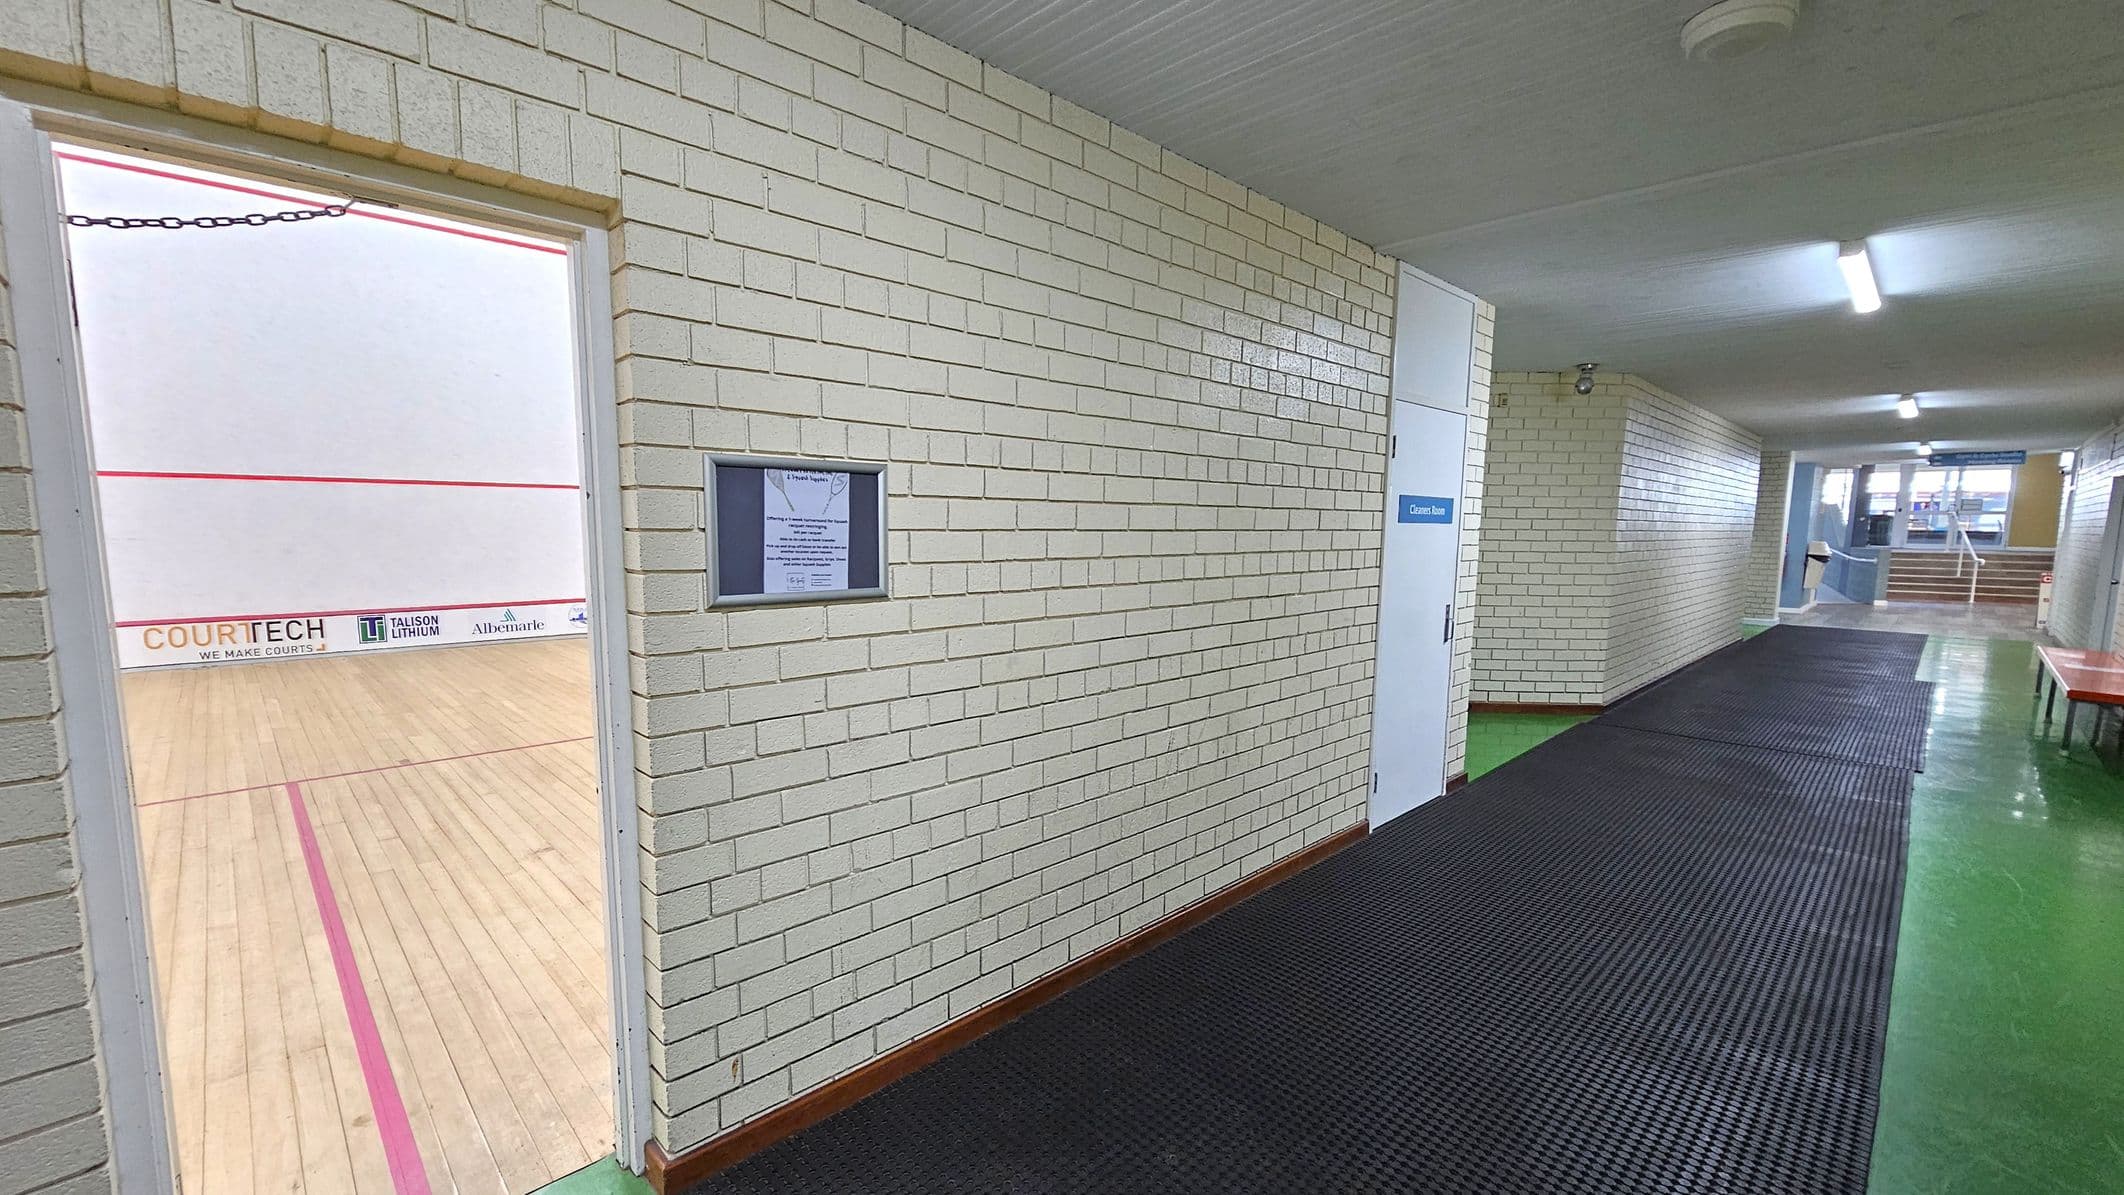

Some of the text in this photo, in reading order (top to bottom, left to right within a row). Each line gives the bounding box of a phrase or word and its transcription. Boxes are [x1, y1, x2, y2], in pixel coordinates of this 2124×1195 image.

[1410, 504, 1445, 516] Cleaners Room
[389, 615, 439, 628] TALISON
[472, 619, 545, 635] Albemarle
[391, 625, 440, 639] LITHIUM
[199, 644, 314, 660] WE MAKE COURTS
